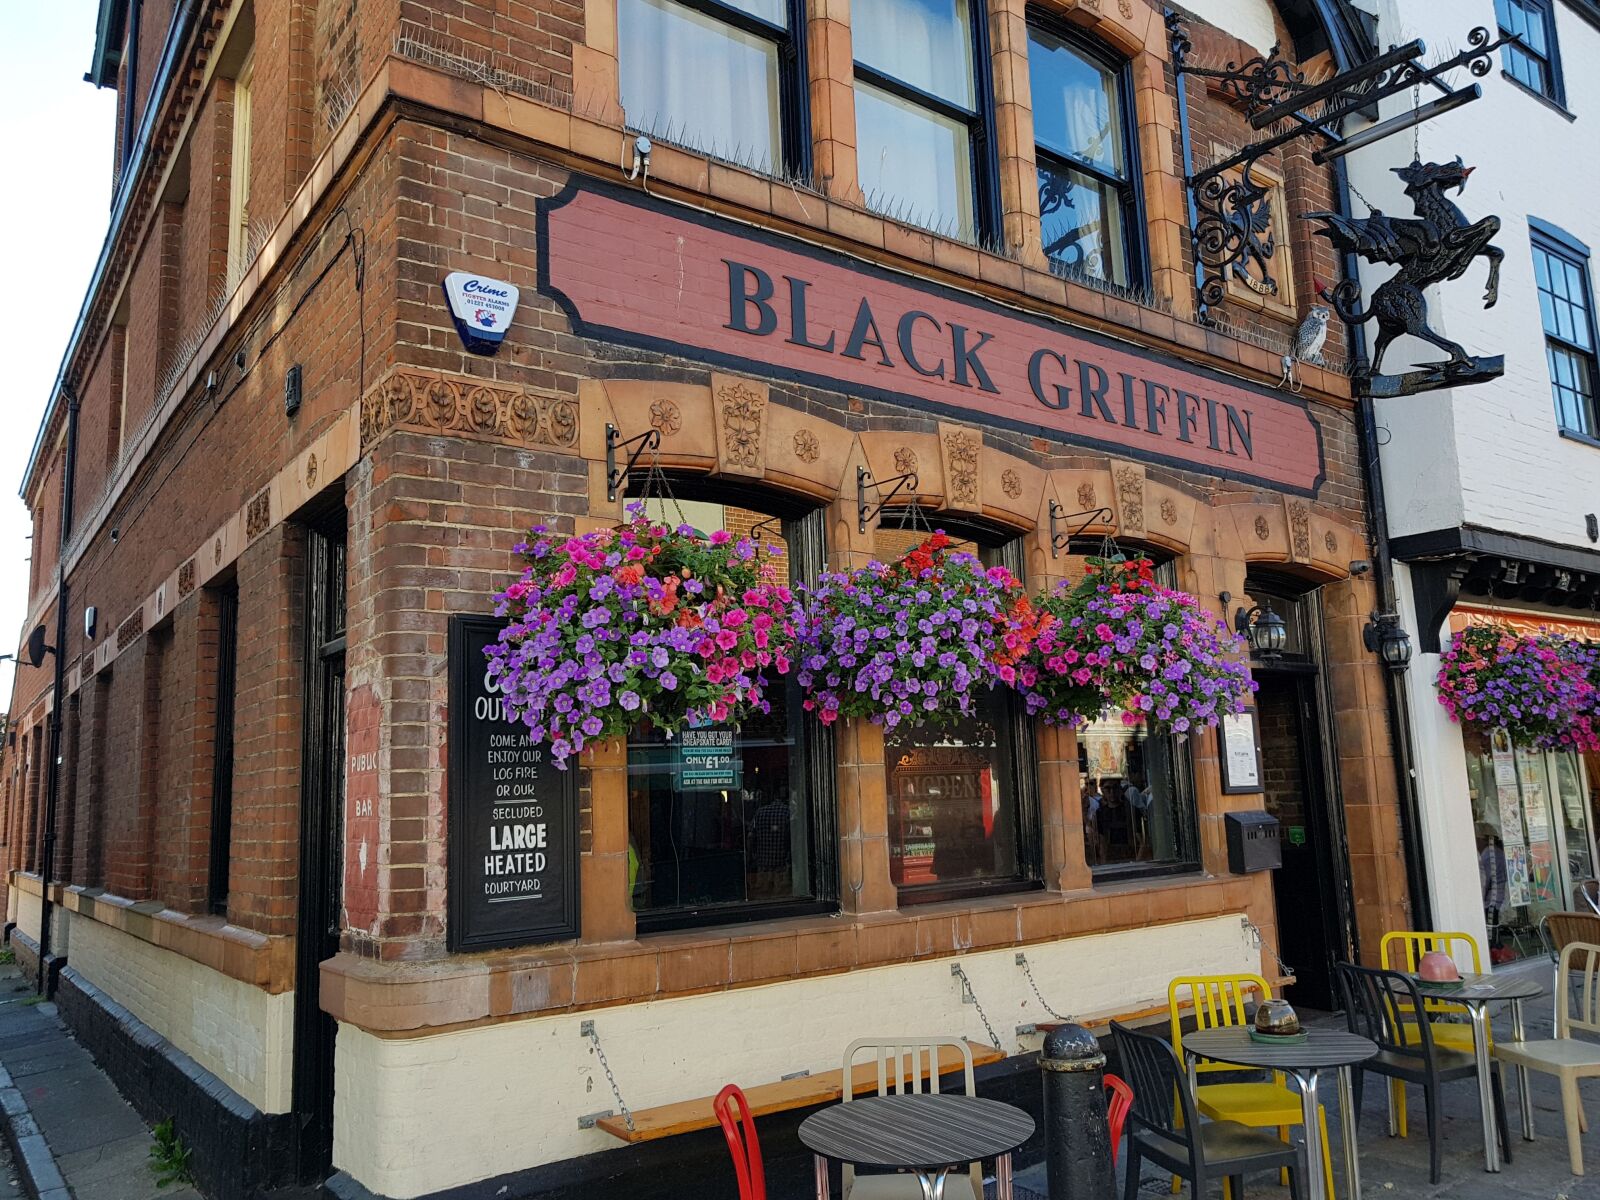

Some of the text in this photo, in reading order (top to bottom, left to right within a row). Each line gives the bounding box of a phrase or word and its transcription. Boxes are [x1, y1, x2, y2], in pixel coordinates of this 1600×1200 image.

[463, 280, 508, 297] Crime
[719, 257, 1254, 461] BLACK GRIFFIN
[490, 734, 517, 747] COME
[682, 731, 733, 739] HAVE YOU GOT YOUR
[682, 738, 715, 746] CHEAPSKATE
[351, 752, 377, 773] PUBLIC
[487, 750, 541, 763] ENJOY OUR
[685, 756, 730, 769] ONLY £1.00
[493, 766, 538, 781] LOG FIRE
[496, 783, 535, 797] OR OUR
[355, 800, 373, 817] BAR
[492, 806, 543, 820] SECLUDED
[490, 823, 547, 851] LARGE
[484, 852, 546, 875] HEATED
[484, 878, 541, 895] COURTYARD
